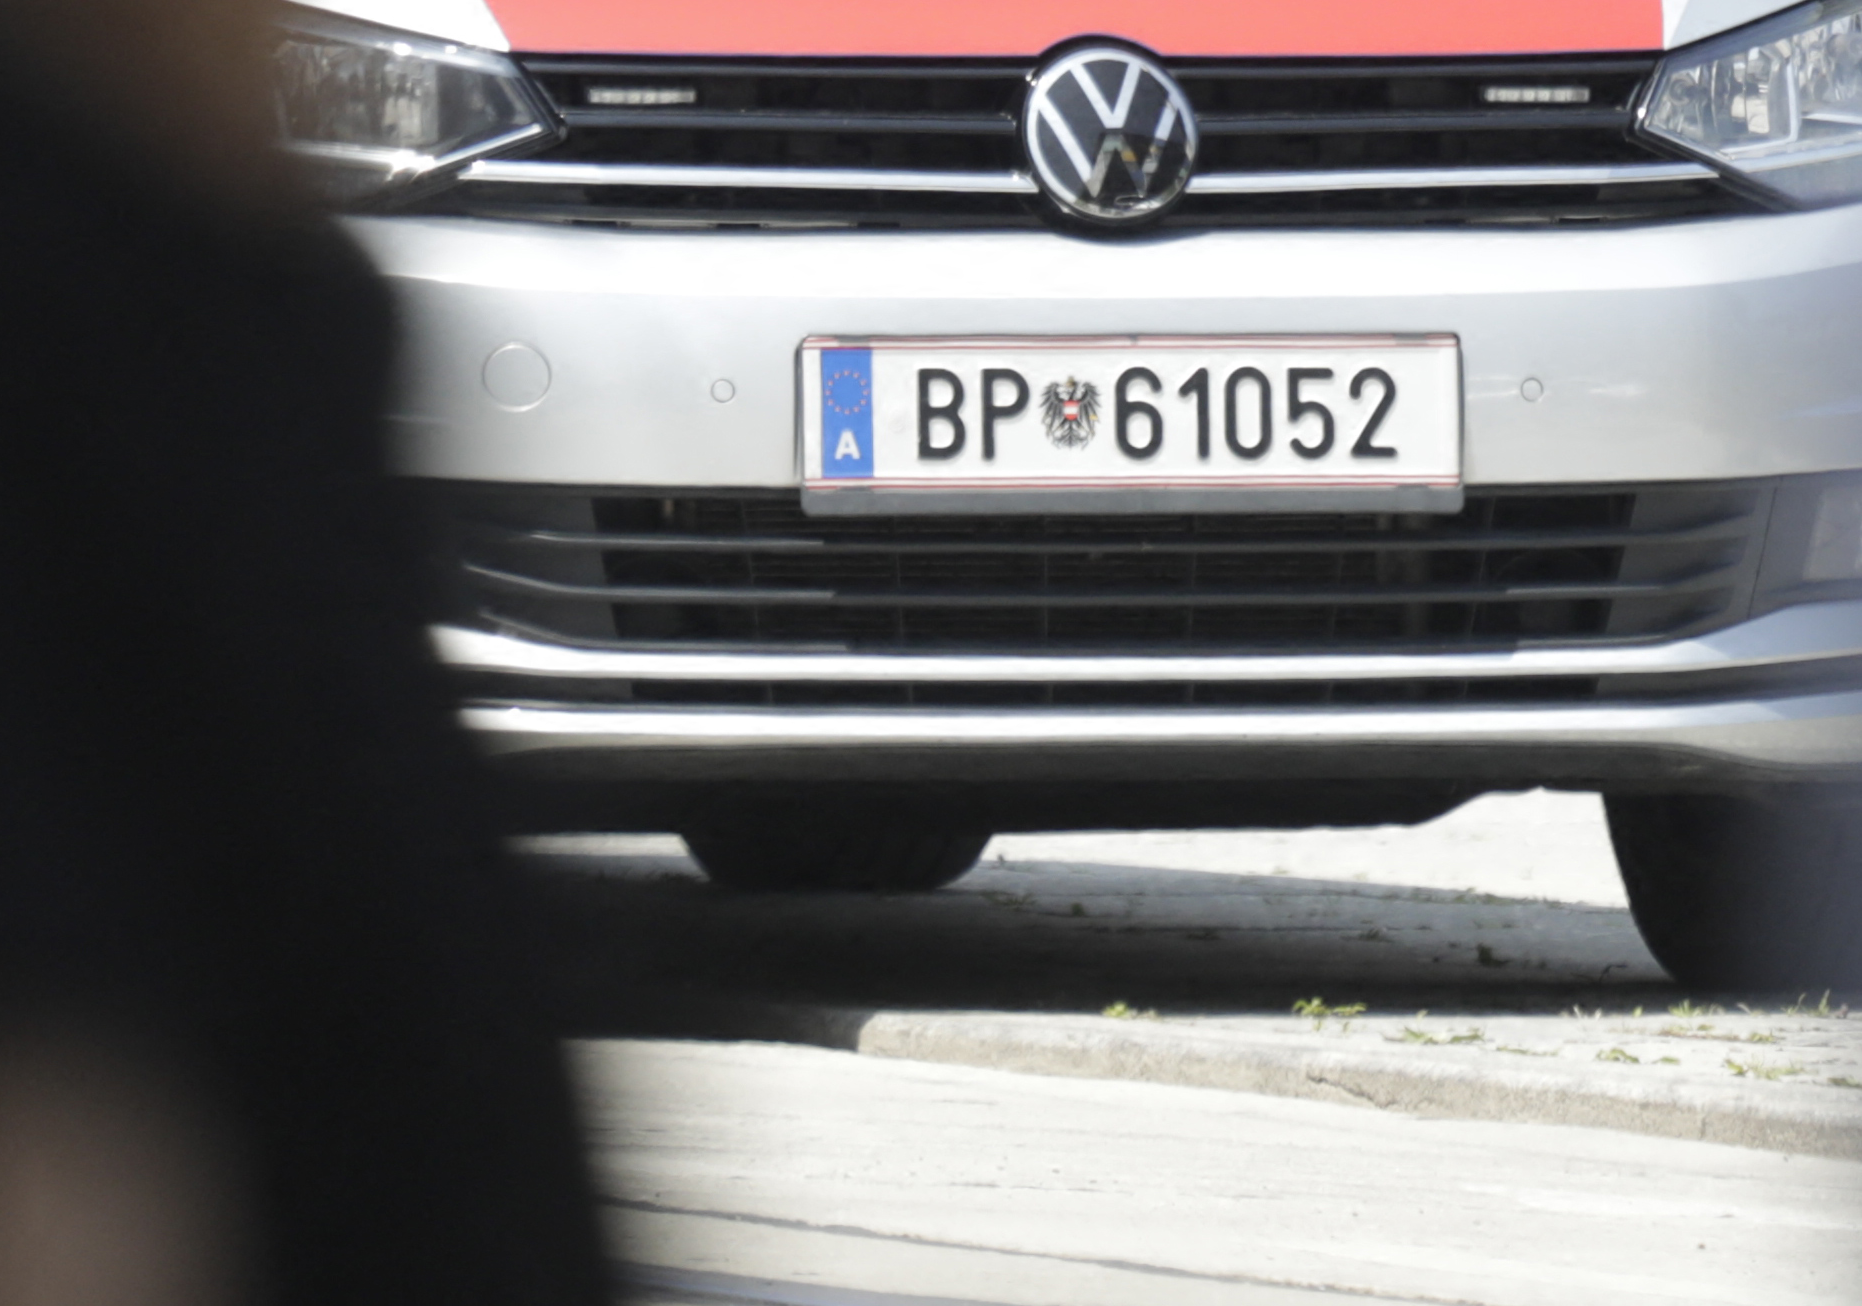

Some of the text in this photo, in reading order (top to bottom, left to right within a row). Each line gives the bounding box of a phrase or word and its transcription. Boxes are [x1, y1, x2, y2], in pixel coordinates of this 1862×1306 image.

[834, 429, 861, 461] A
[916, 365, 1399, 461] BP 61052
